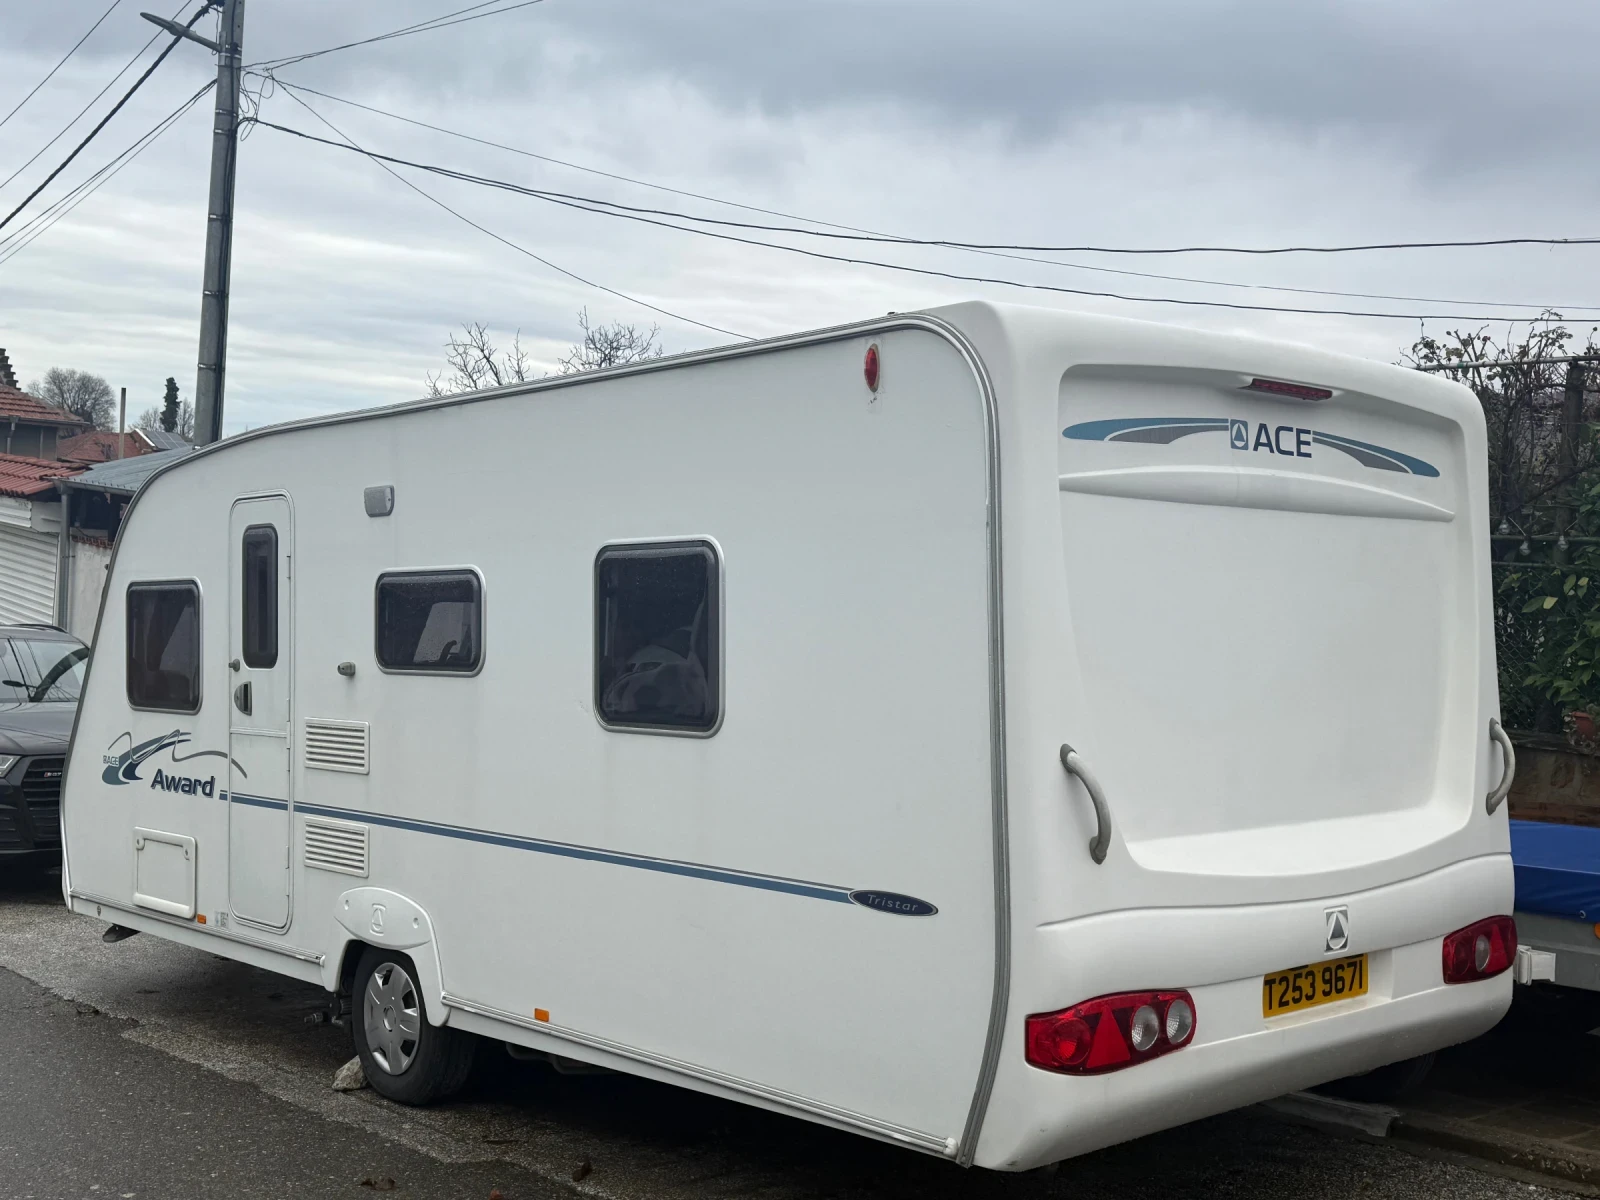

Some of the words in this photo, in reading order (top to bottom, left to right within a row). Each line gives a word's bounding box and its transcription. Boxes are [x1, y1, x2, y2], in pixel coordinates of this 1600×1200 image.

[1253, 423, 1312, 458] ACE
[151, 768, 215, 798] Award
[867, 894, 918, 912] Tristar
[1264, 970, 1316, 1010] T253
